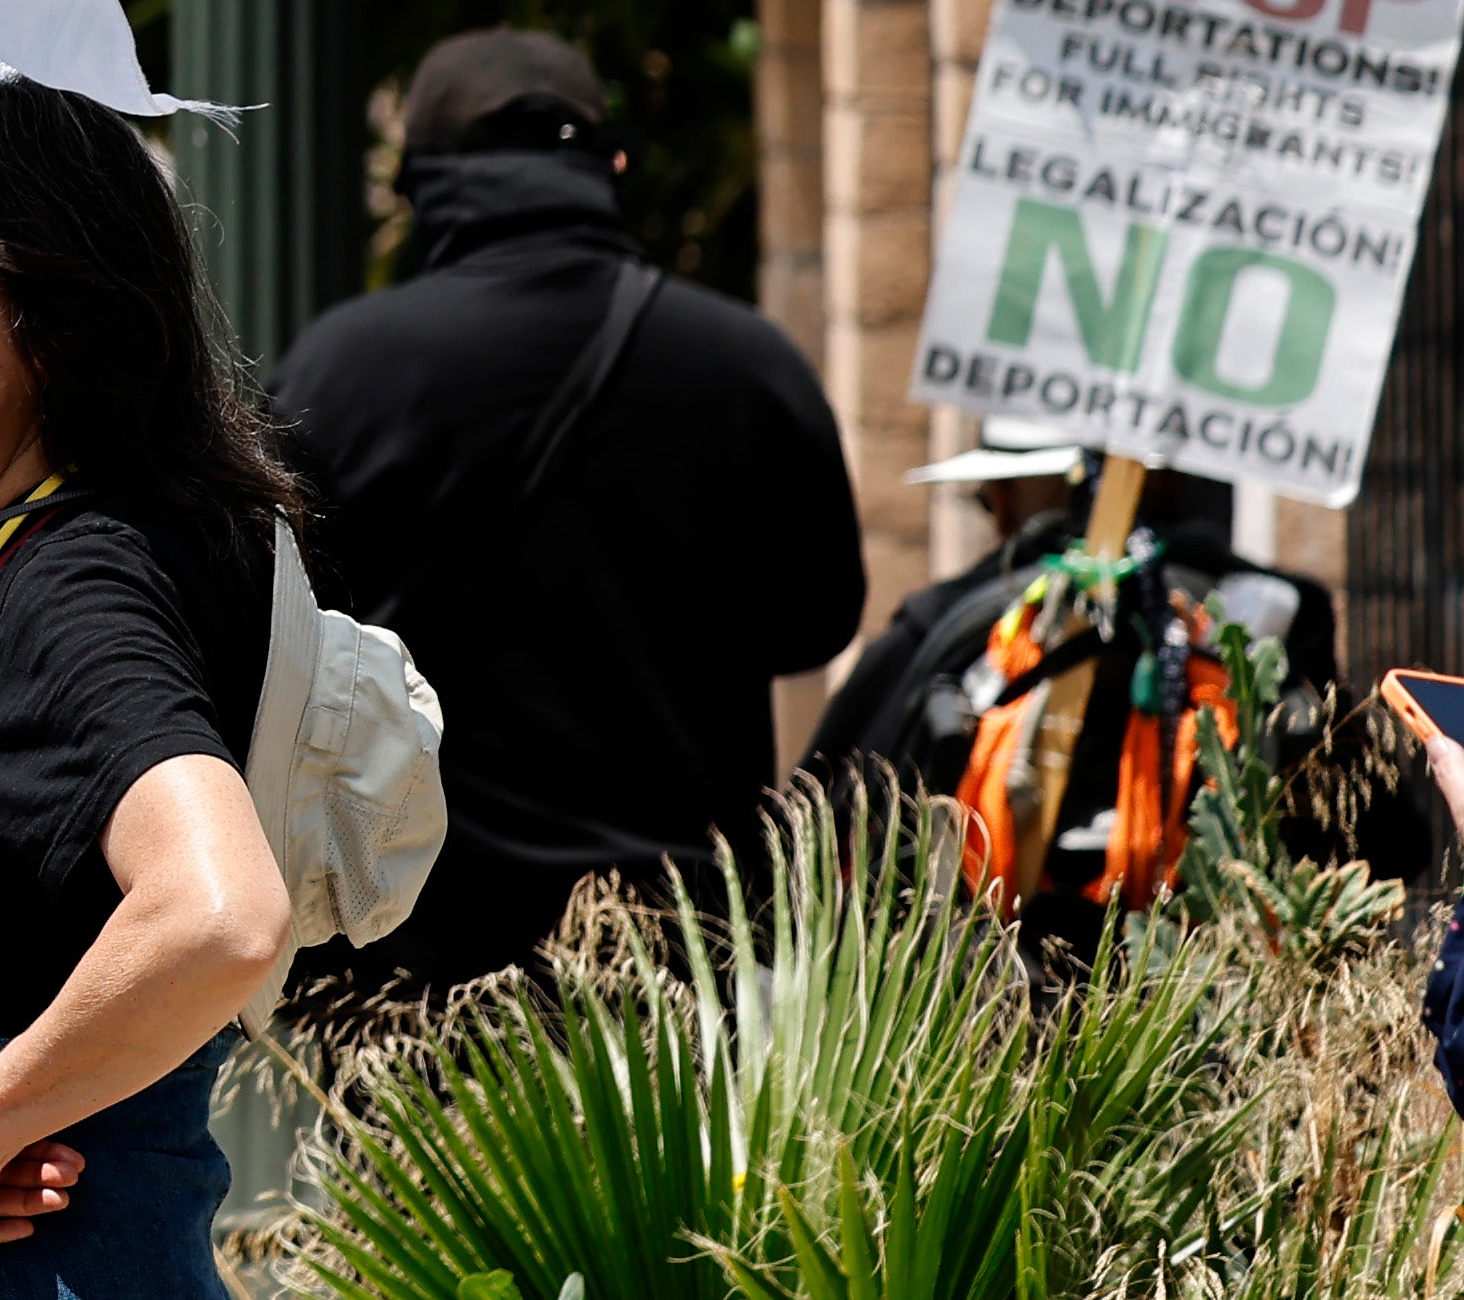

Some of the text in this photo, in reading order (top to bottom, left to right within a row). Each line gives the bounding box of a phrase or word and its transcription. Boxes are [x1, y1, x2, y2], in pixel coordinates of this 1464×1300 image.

[992, 60, 1420, 185] FOR IMMIGRANTS!
[1060, 32, 1366, 129] FULL RIGHTS
[968, 133, 1406, 272] LEGALIZACIÓN!
[986, 197, 1336, 409] NO
[923, 347, 1355, 481] DEPORTACIÓN!
